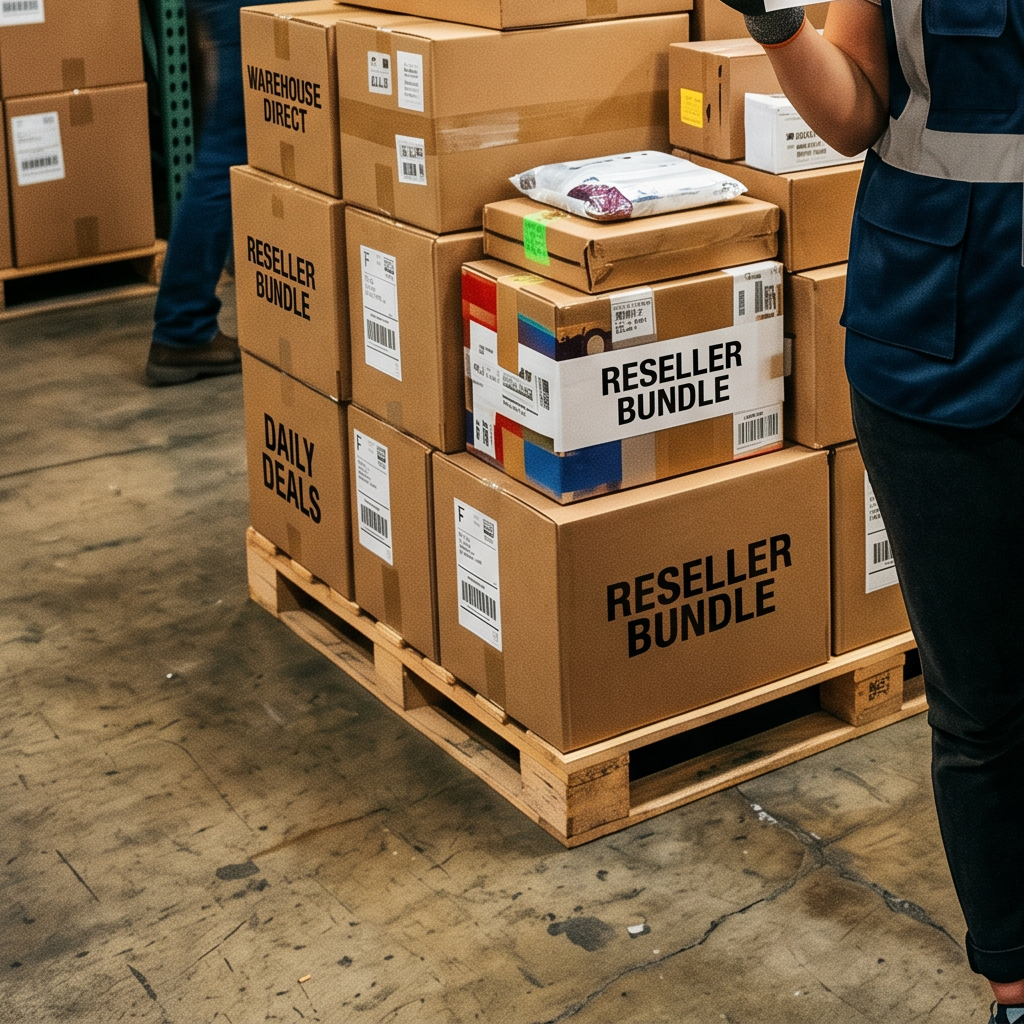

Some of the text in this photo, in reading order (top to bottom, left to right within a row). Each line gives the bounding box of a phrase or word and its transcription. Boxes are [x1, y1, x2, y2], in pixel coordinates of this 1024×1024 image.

[247, 64, 322, 110] WAREHOUSE
[263, 97, 308, 134] DIRECT
[247, 234, 316, 291] RESELLER
[363, 250, 370, 268] F
[255, 270, 312, 322] BUNDLE
[601, 340, 743, 396] RESELLER
[617, 374, 730, 426] BUNDLE
[263, 411, 315, 478] DAILY
[356, 434, 362, 451] F
[261, 451, 322, 525] DEALS
[457, 505, 465, 523] F
[606, 533, 793, 623] RESELLER
[627, 577, 776, 659] BUNDLE
